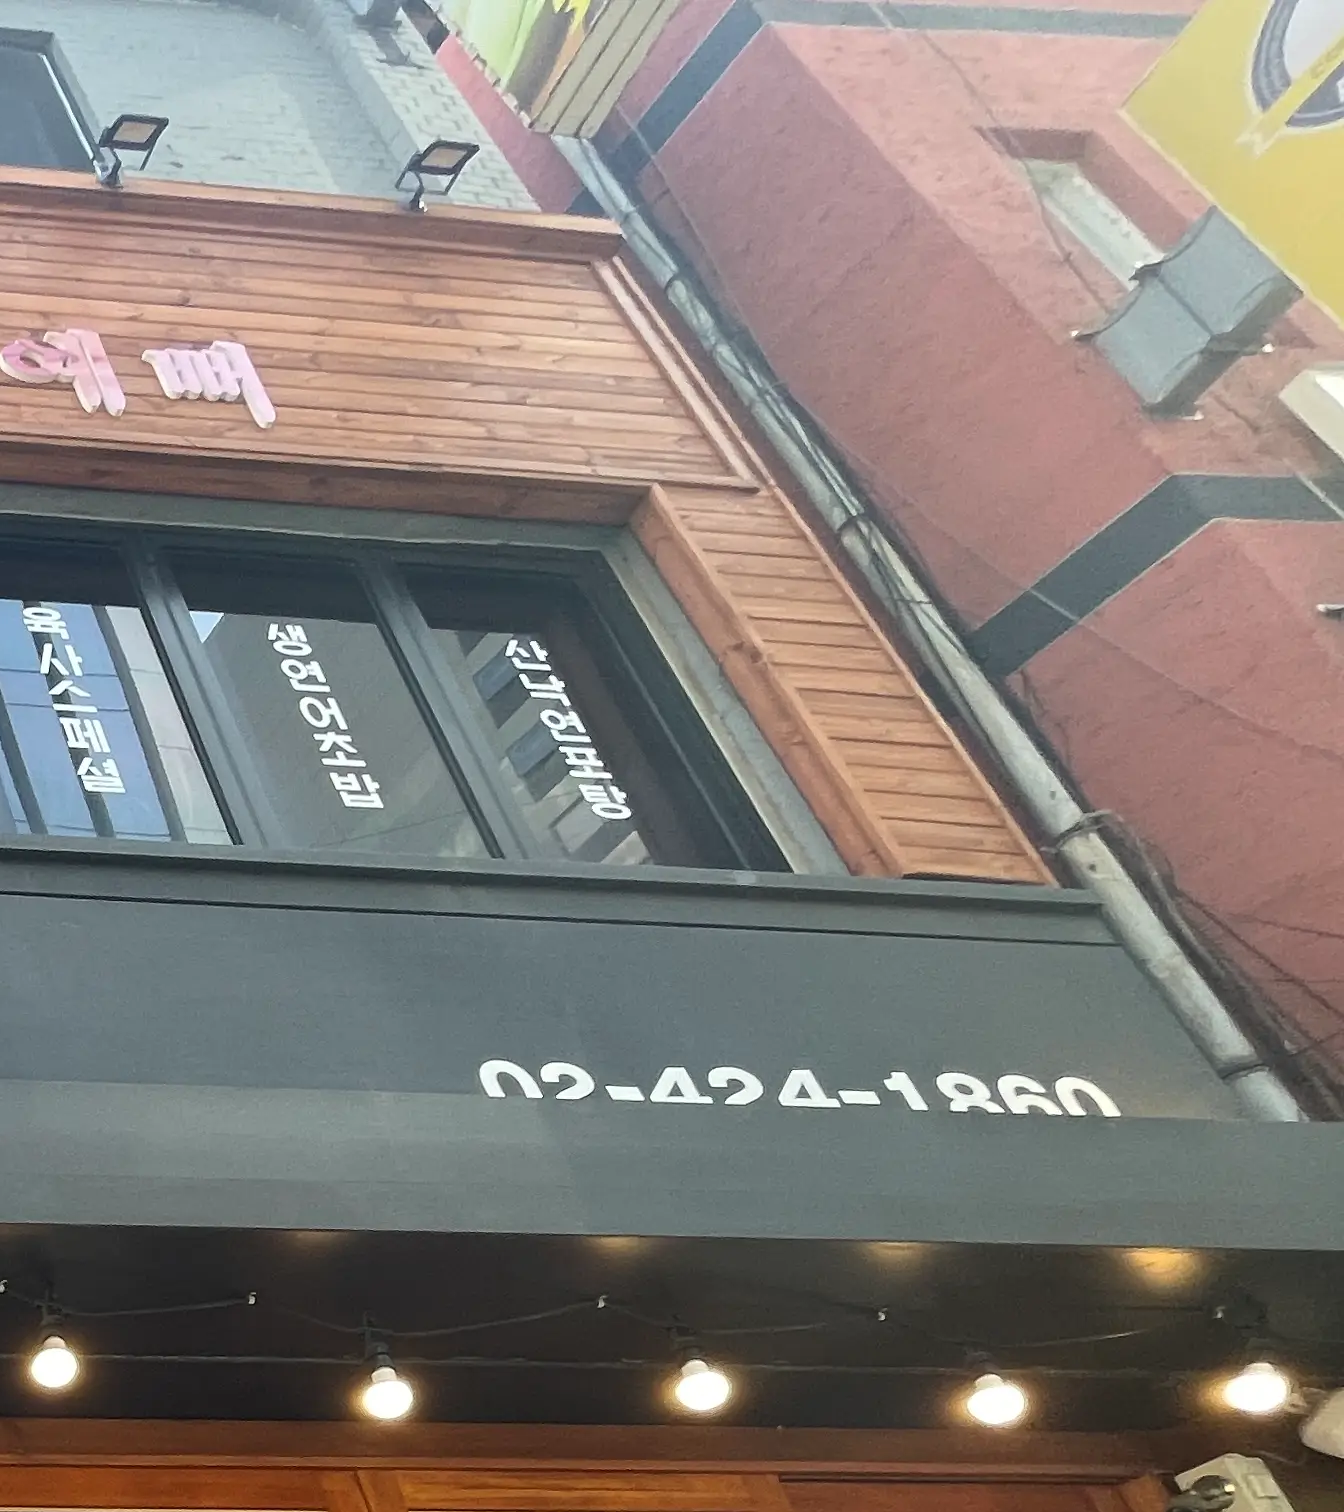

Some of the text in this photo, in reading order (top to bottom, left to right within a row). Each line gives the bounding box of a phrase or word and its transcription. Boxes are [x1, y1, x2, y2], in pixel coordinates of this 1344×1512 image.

[22, 606, 126, 794] 육사스페셜
[267, 622, 384, 810] 생연어초밥
[504, 638, 633, 821] 산낙연포탕
